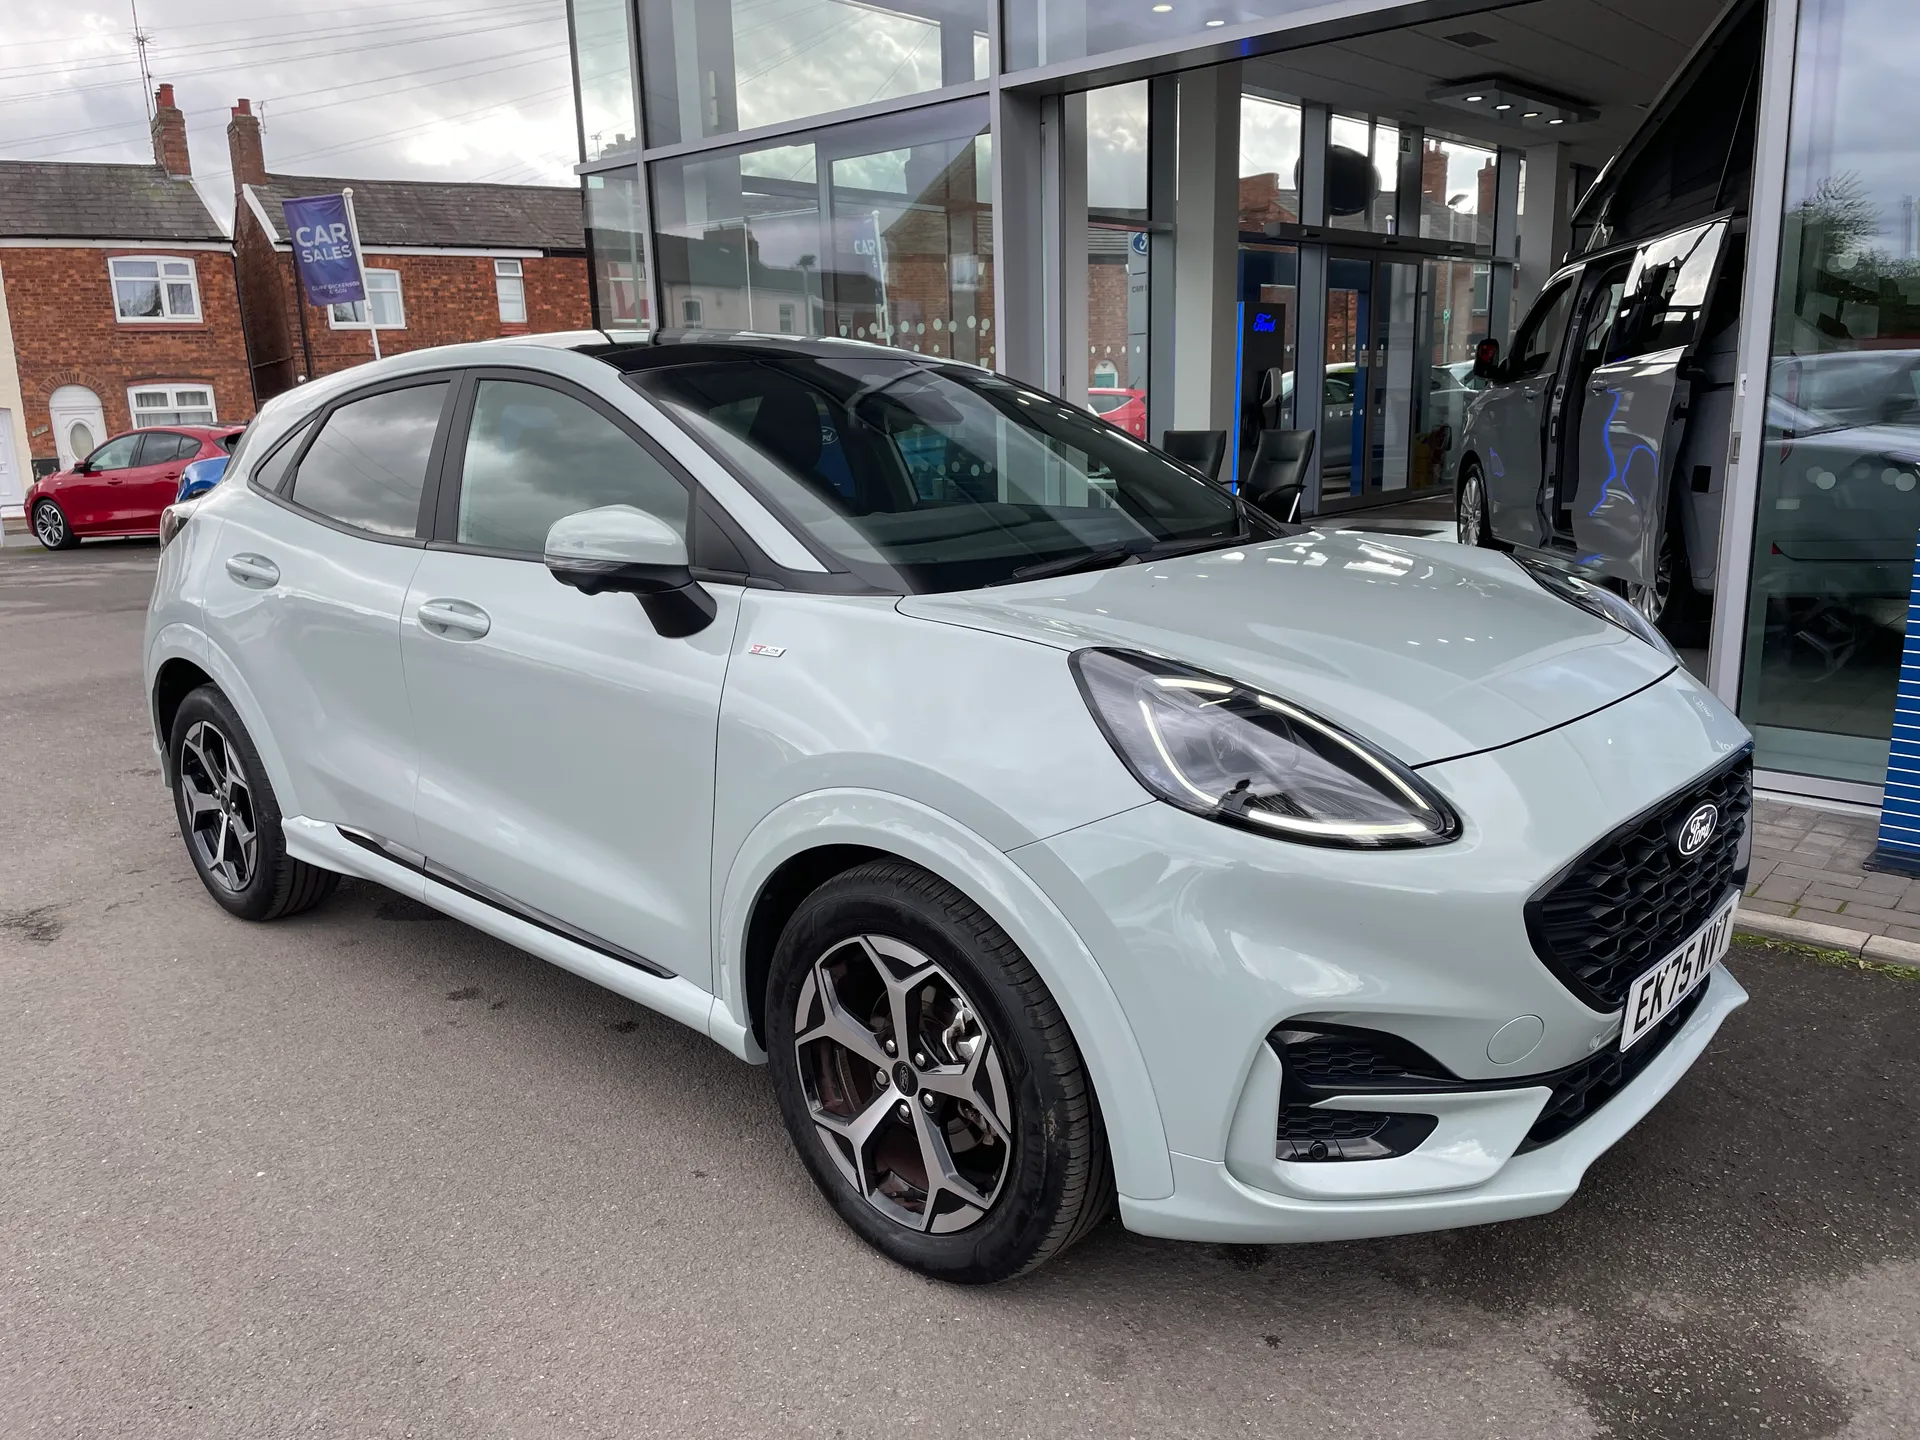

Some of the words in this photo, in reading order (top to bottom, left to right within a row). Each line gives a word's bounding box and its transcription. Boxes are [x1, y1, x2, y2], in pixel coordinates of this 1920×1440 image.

[295, 222, 349, 248] CAR
[301, 244, 353, 263] SALES
[853, 239, 876, 255] CAR
[1253, 313, 1277, 332] Ford
[1686, 811, 1712, 850] Ford
